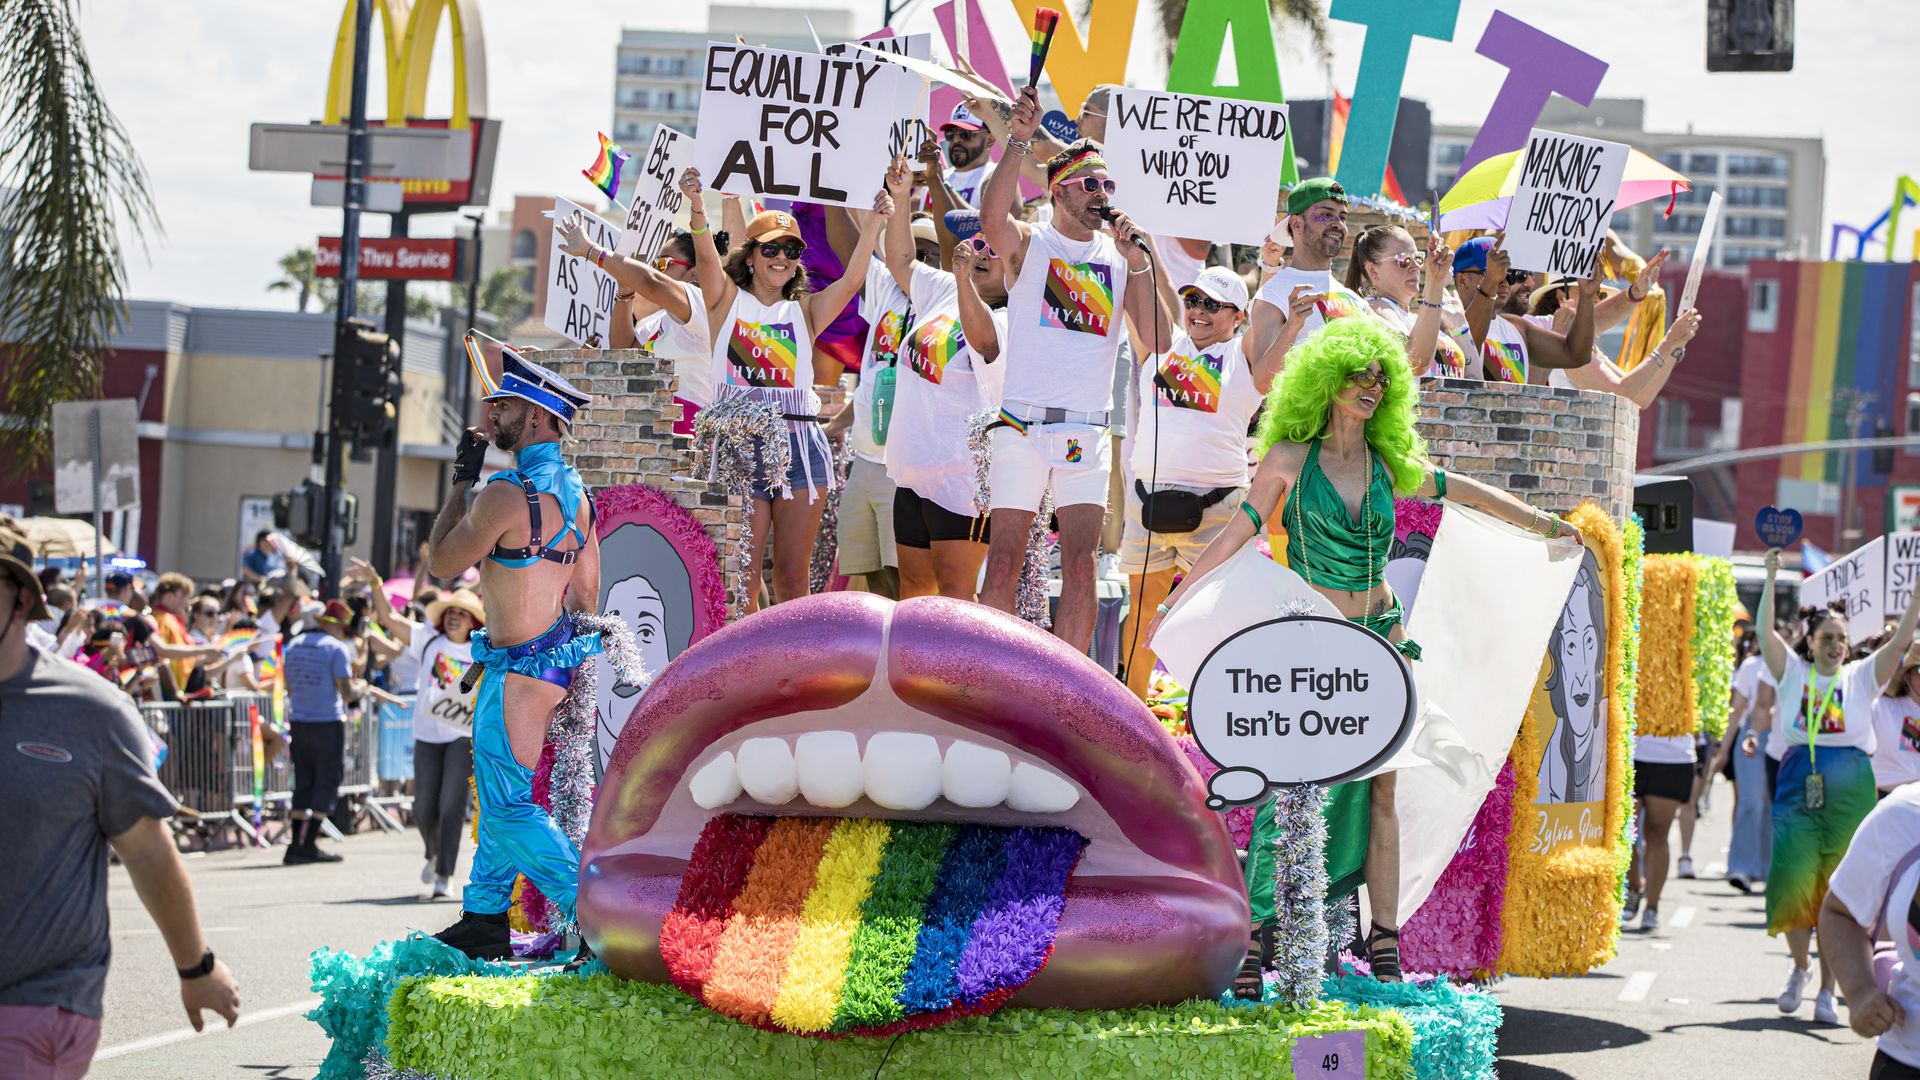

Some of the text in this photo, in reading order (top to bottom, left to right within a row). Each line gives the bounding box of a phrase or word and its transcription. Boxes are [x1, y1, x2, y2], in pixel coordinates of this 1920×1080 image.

[705, 46, 881, 108] EQUALITY
[759, 104, 841, 150] FOR
[1116, 94, 1287, 141] WE'RE PROUD
[647, 128, 678, 181] BE
[1179, 134, 1200, 149] OF
[711, 140, 848, 202] ALL
[1141, 149, 1230, 179] WHO YOU
[1520, 137, 1604, 194] MAKING
[1167, 180, 1217, 205] ARE
[627, 195, 652, 233] GET
[1526, 191, 1615, 243] HISTORY
[396, 247, 450, 269] Service
[1547, 237, 1605, 278] NOW!
[556, 255, 579, 295] AS
[1069, 290, 1090, 304] OF
[565, 298, 605, 347] ARE
[738, 324, 790, 340] WORLD
[1048, 306, 1106, 328] HYATT
[751, 346, 773, 358] OF
[1169, 357, 1218, 370] WORLD
[732, 365, 789, 381] HYATT
[1501, 367, 1512, 379] OF
[1157, 387, 1212, 405] HYATT
[1825, 551, 1866, 598] PRIDE
[1225, 667, 1368, 700] The Fight
[1226, 710, 1369, 736] Isn't Over
[1322, 1053, 1339, 1071] 49
